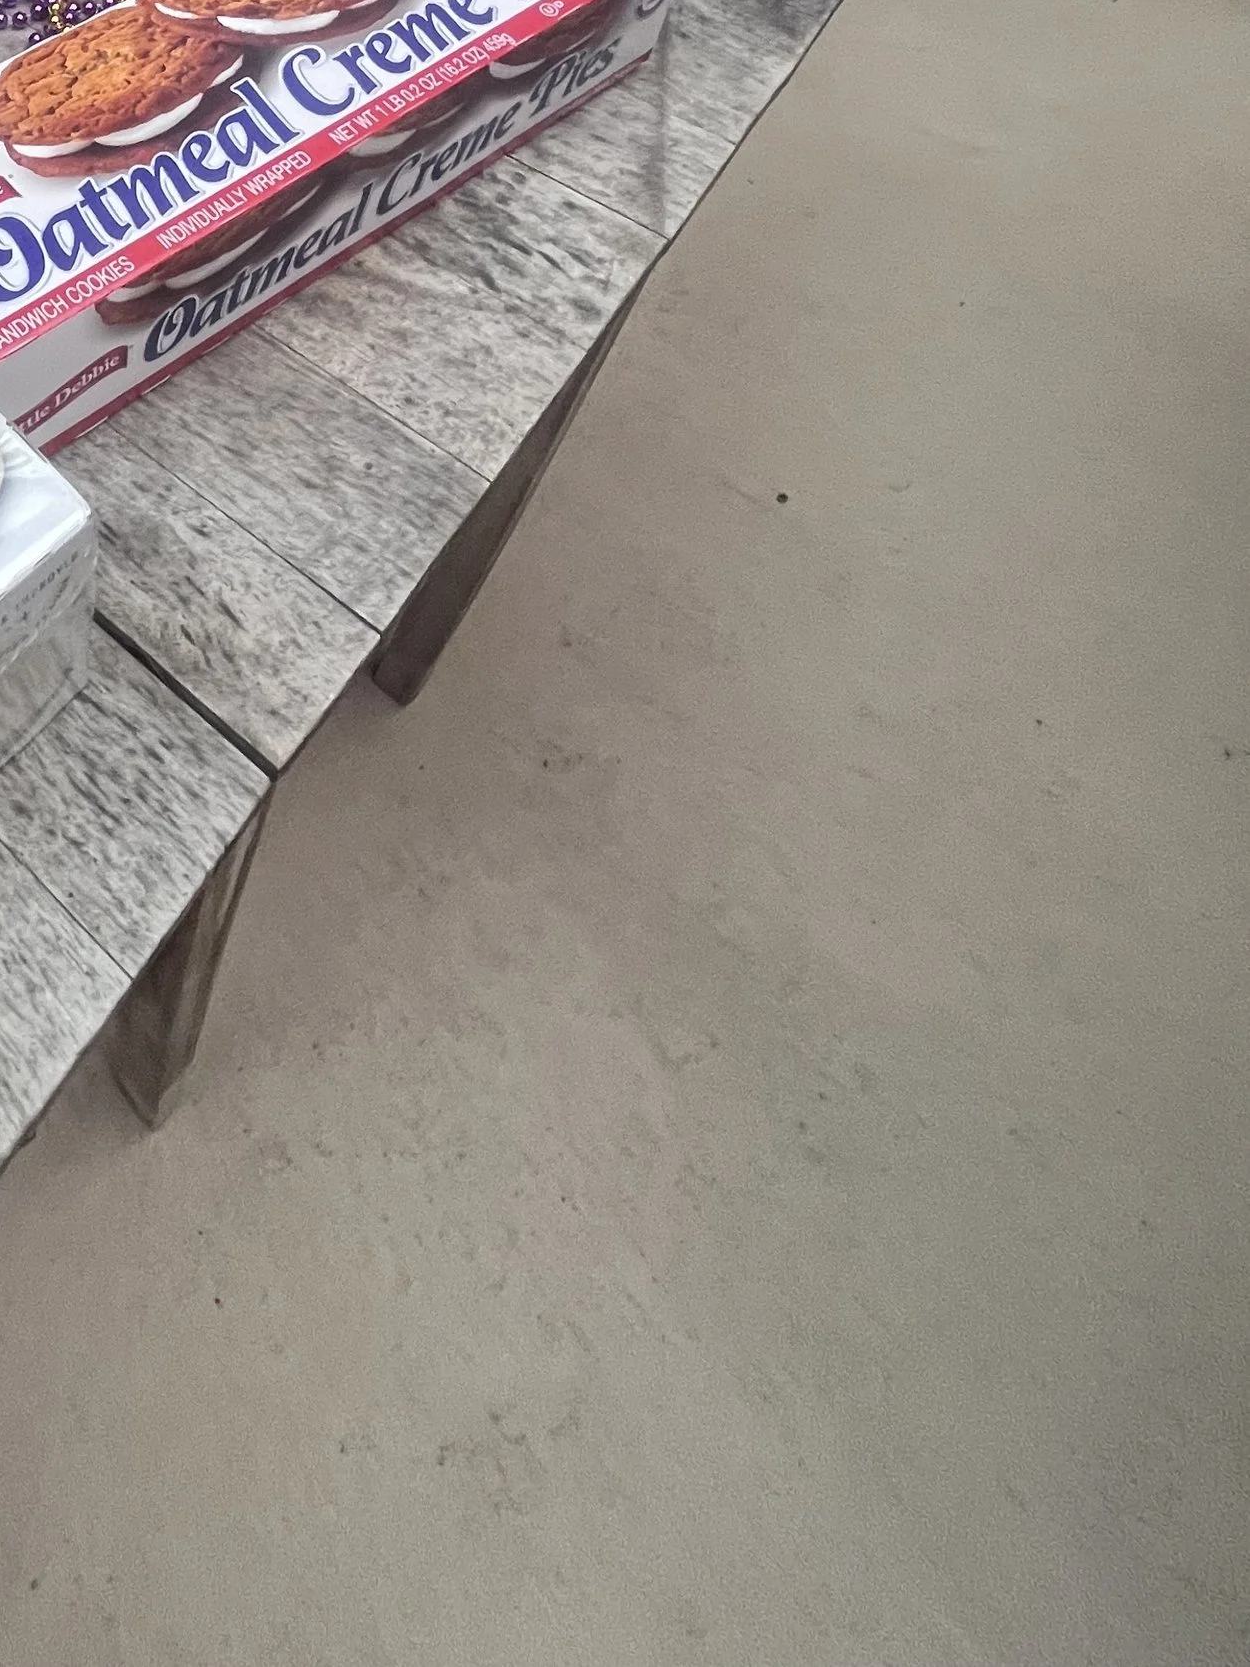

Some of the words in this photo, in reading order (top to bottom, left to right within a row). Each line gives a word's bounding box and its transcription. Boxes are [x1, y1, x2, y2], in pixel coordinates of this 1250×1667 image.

[66, 255, 135, 311] COOKIES
[156, 188, 246, 249] INDIVIDUALLY
[243, 150, 312, 201] WRAPPED
[328, 122, 358, 145] NET
[354, 108, 380, 130] WT
[376, 104, 385, 117] 1
[386, 93, 405, 112] LB
[403, 84, 424, 105] 0.2
[419, 71, 443, 92] OZ
[437, 56, 467, 83] (16.2
[462, 45, 489, 70] OZ)
[482, 32, 516, 57] 459g
[143, 181, 374, 362] Oatmeal
[378, 101, 523, 215] Creme
[530, 36, 623, 117] Pies
[53, 355, 121, 408] Debbie
